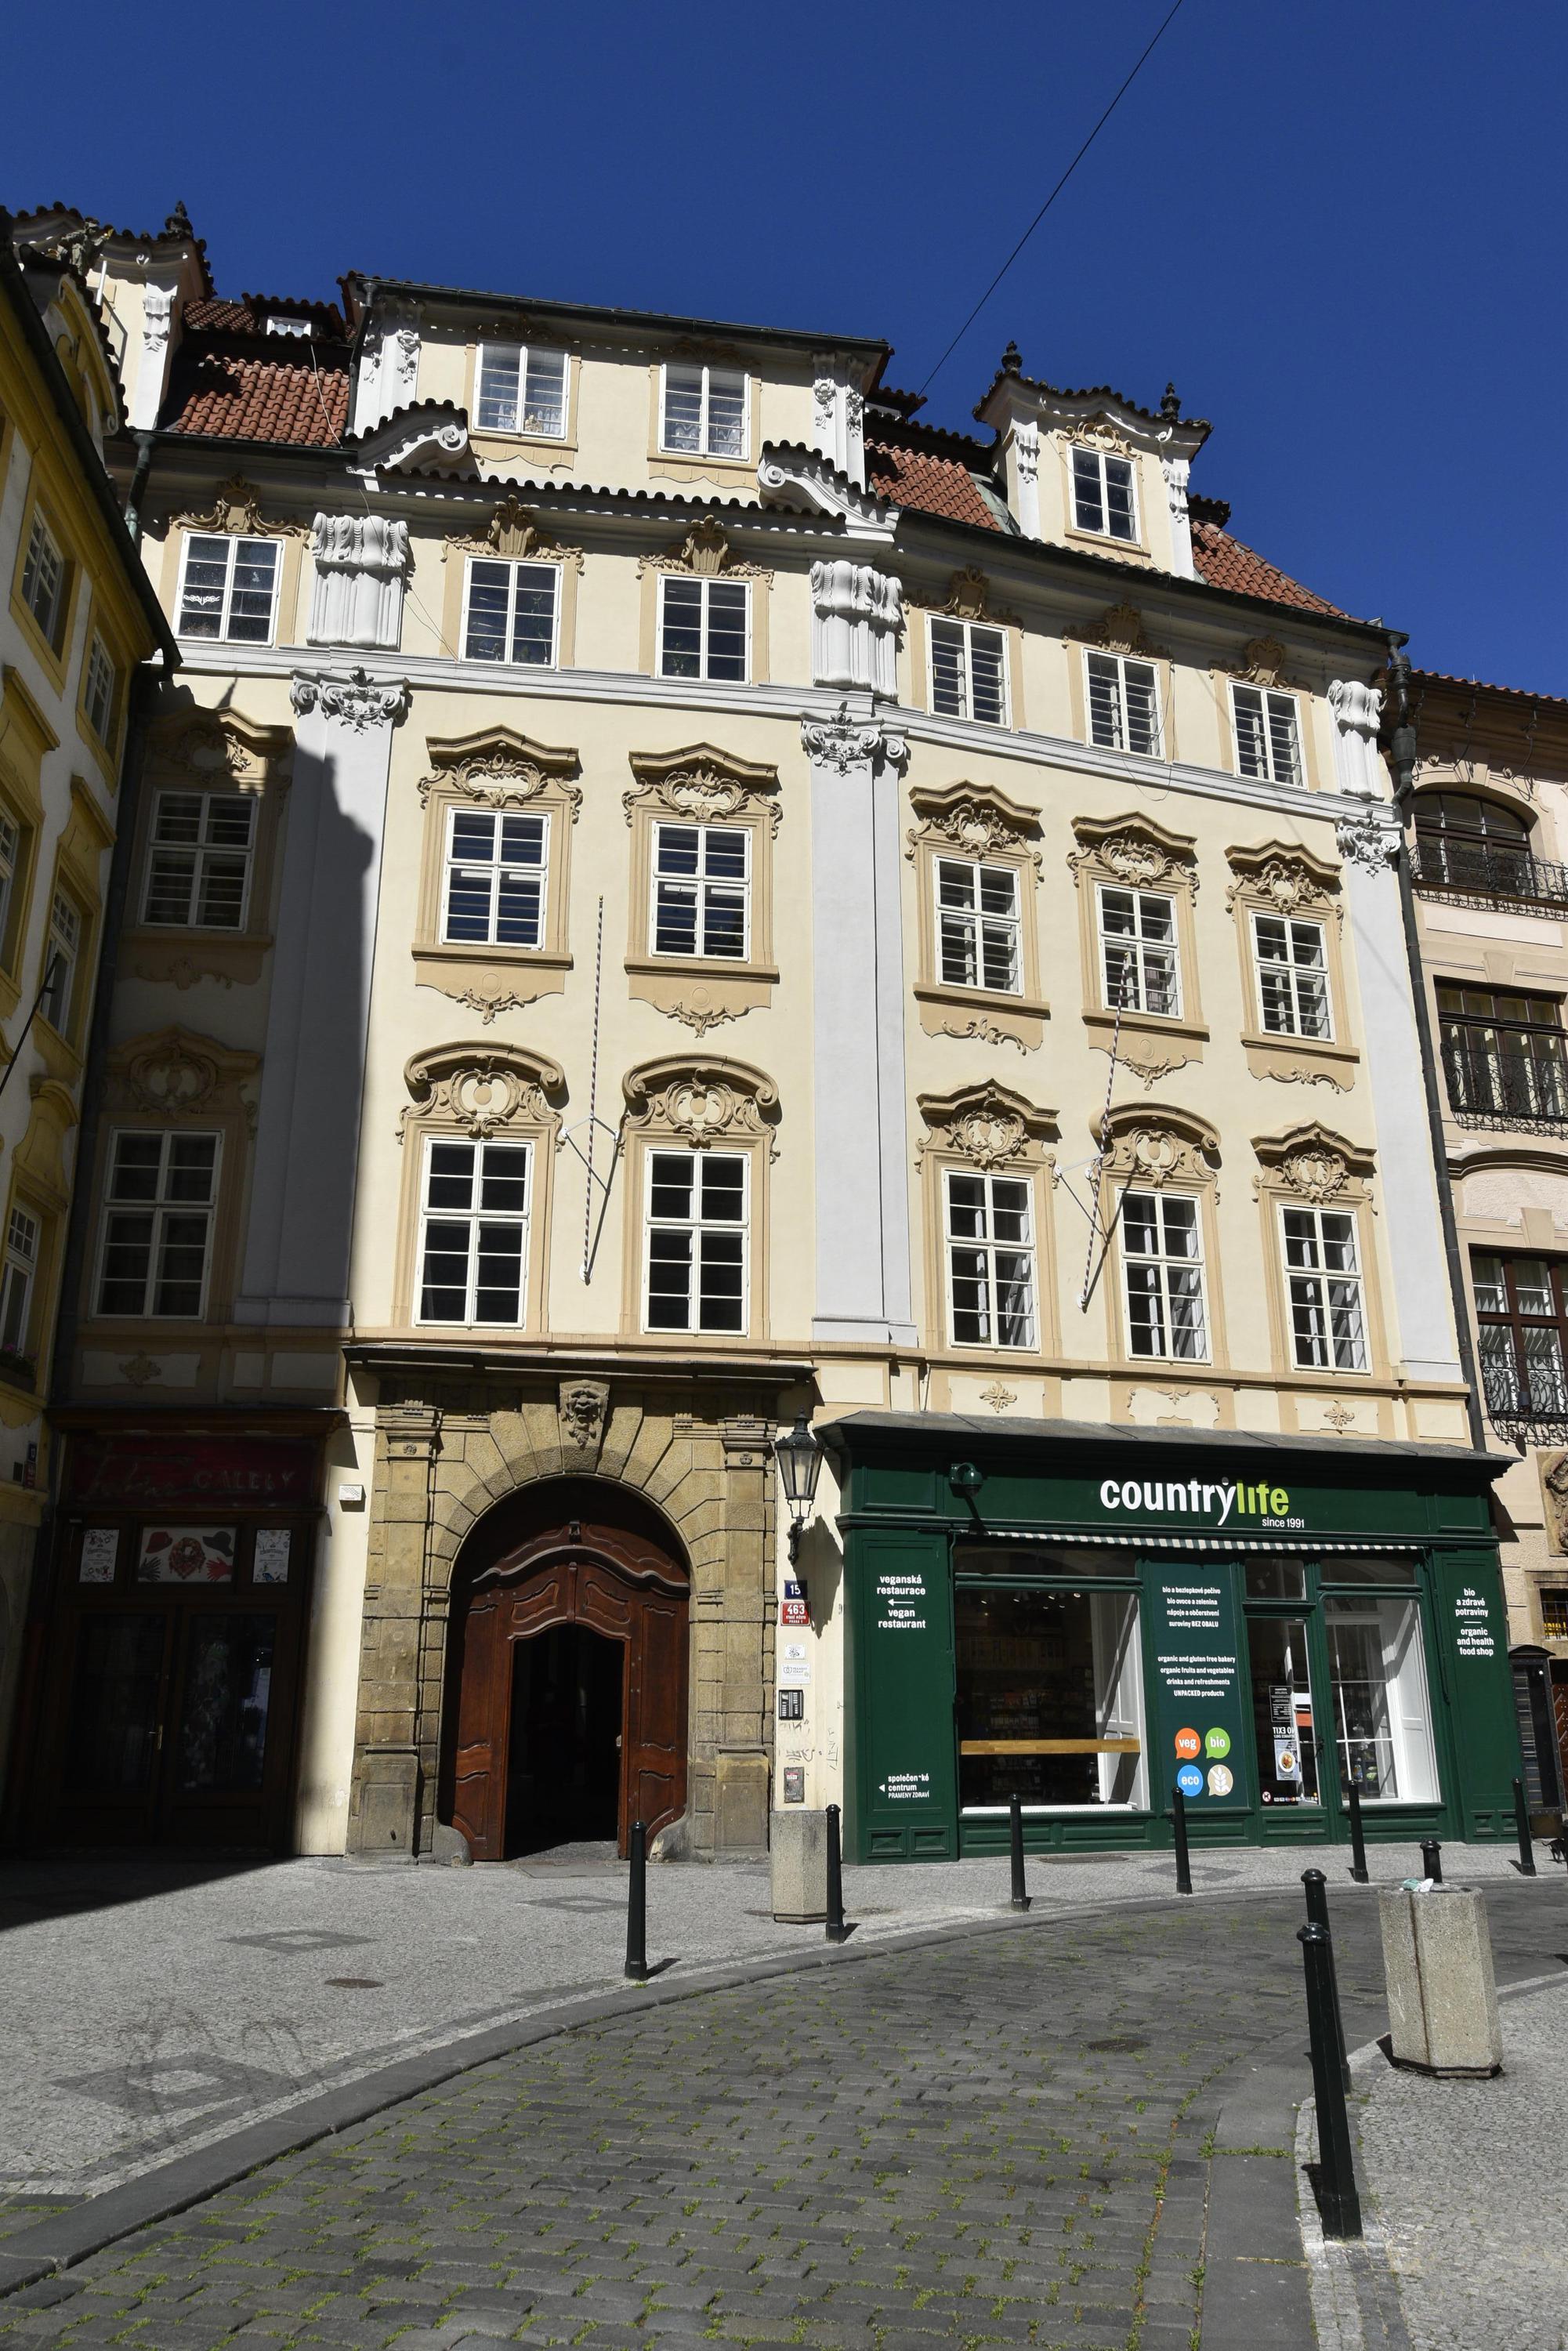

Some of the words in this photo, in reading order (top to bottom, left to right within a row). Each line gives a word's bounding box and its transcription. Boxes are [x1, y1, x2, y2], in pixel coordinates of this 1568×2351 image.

[1262, 1517, 1285, 1527] since
[1286, 1518, 1305, 1528] 1991
[879, 1574, 922, 1585] veganská
[790, 1584, 801, 1595] 15
[877, 1585, 925, 1595] restaurace
[1175, 1586, 1204, 1595] bezlepkové
[1463, 1588, 1476, 1596] bio
[1461, 1597, 1486, 1607] zdravé
[787, 1604, 805, 1614] 463
[1455, 1607, 1489, 1617] potraviny
[888, 1610, 915, 1619] vegan
[878, 1619, 926, 1628] restaurant
[1460, 1627, 1488, 1637] organic
[1471, 1637, 1494, 1646] health
[1459, 1646, 1476, 1655] food
[1476, 1647, 1494, 1657] shop
[1179, 1738, 1197, 1751] veg
[1210, 1736, 1226, 1748] bio
[1181, 1776, 1200, 1785] eco
